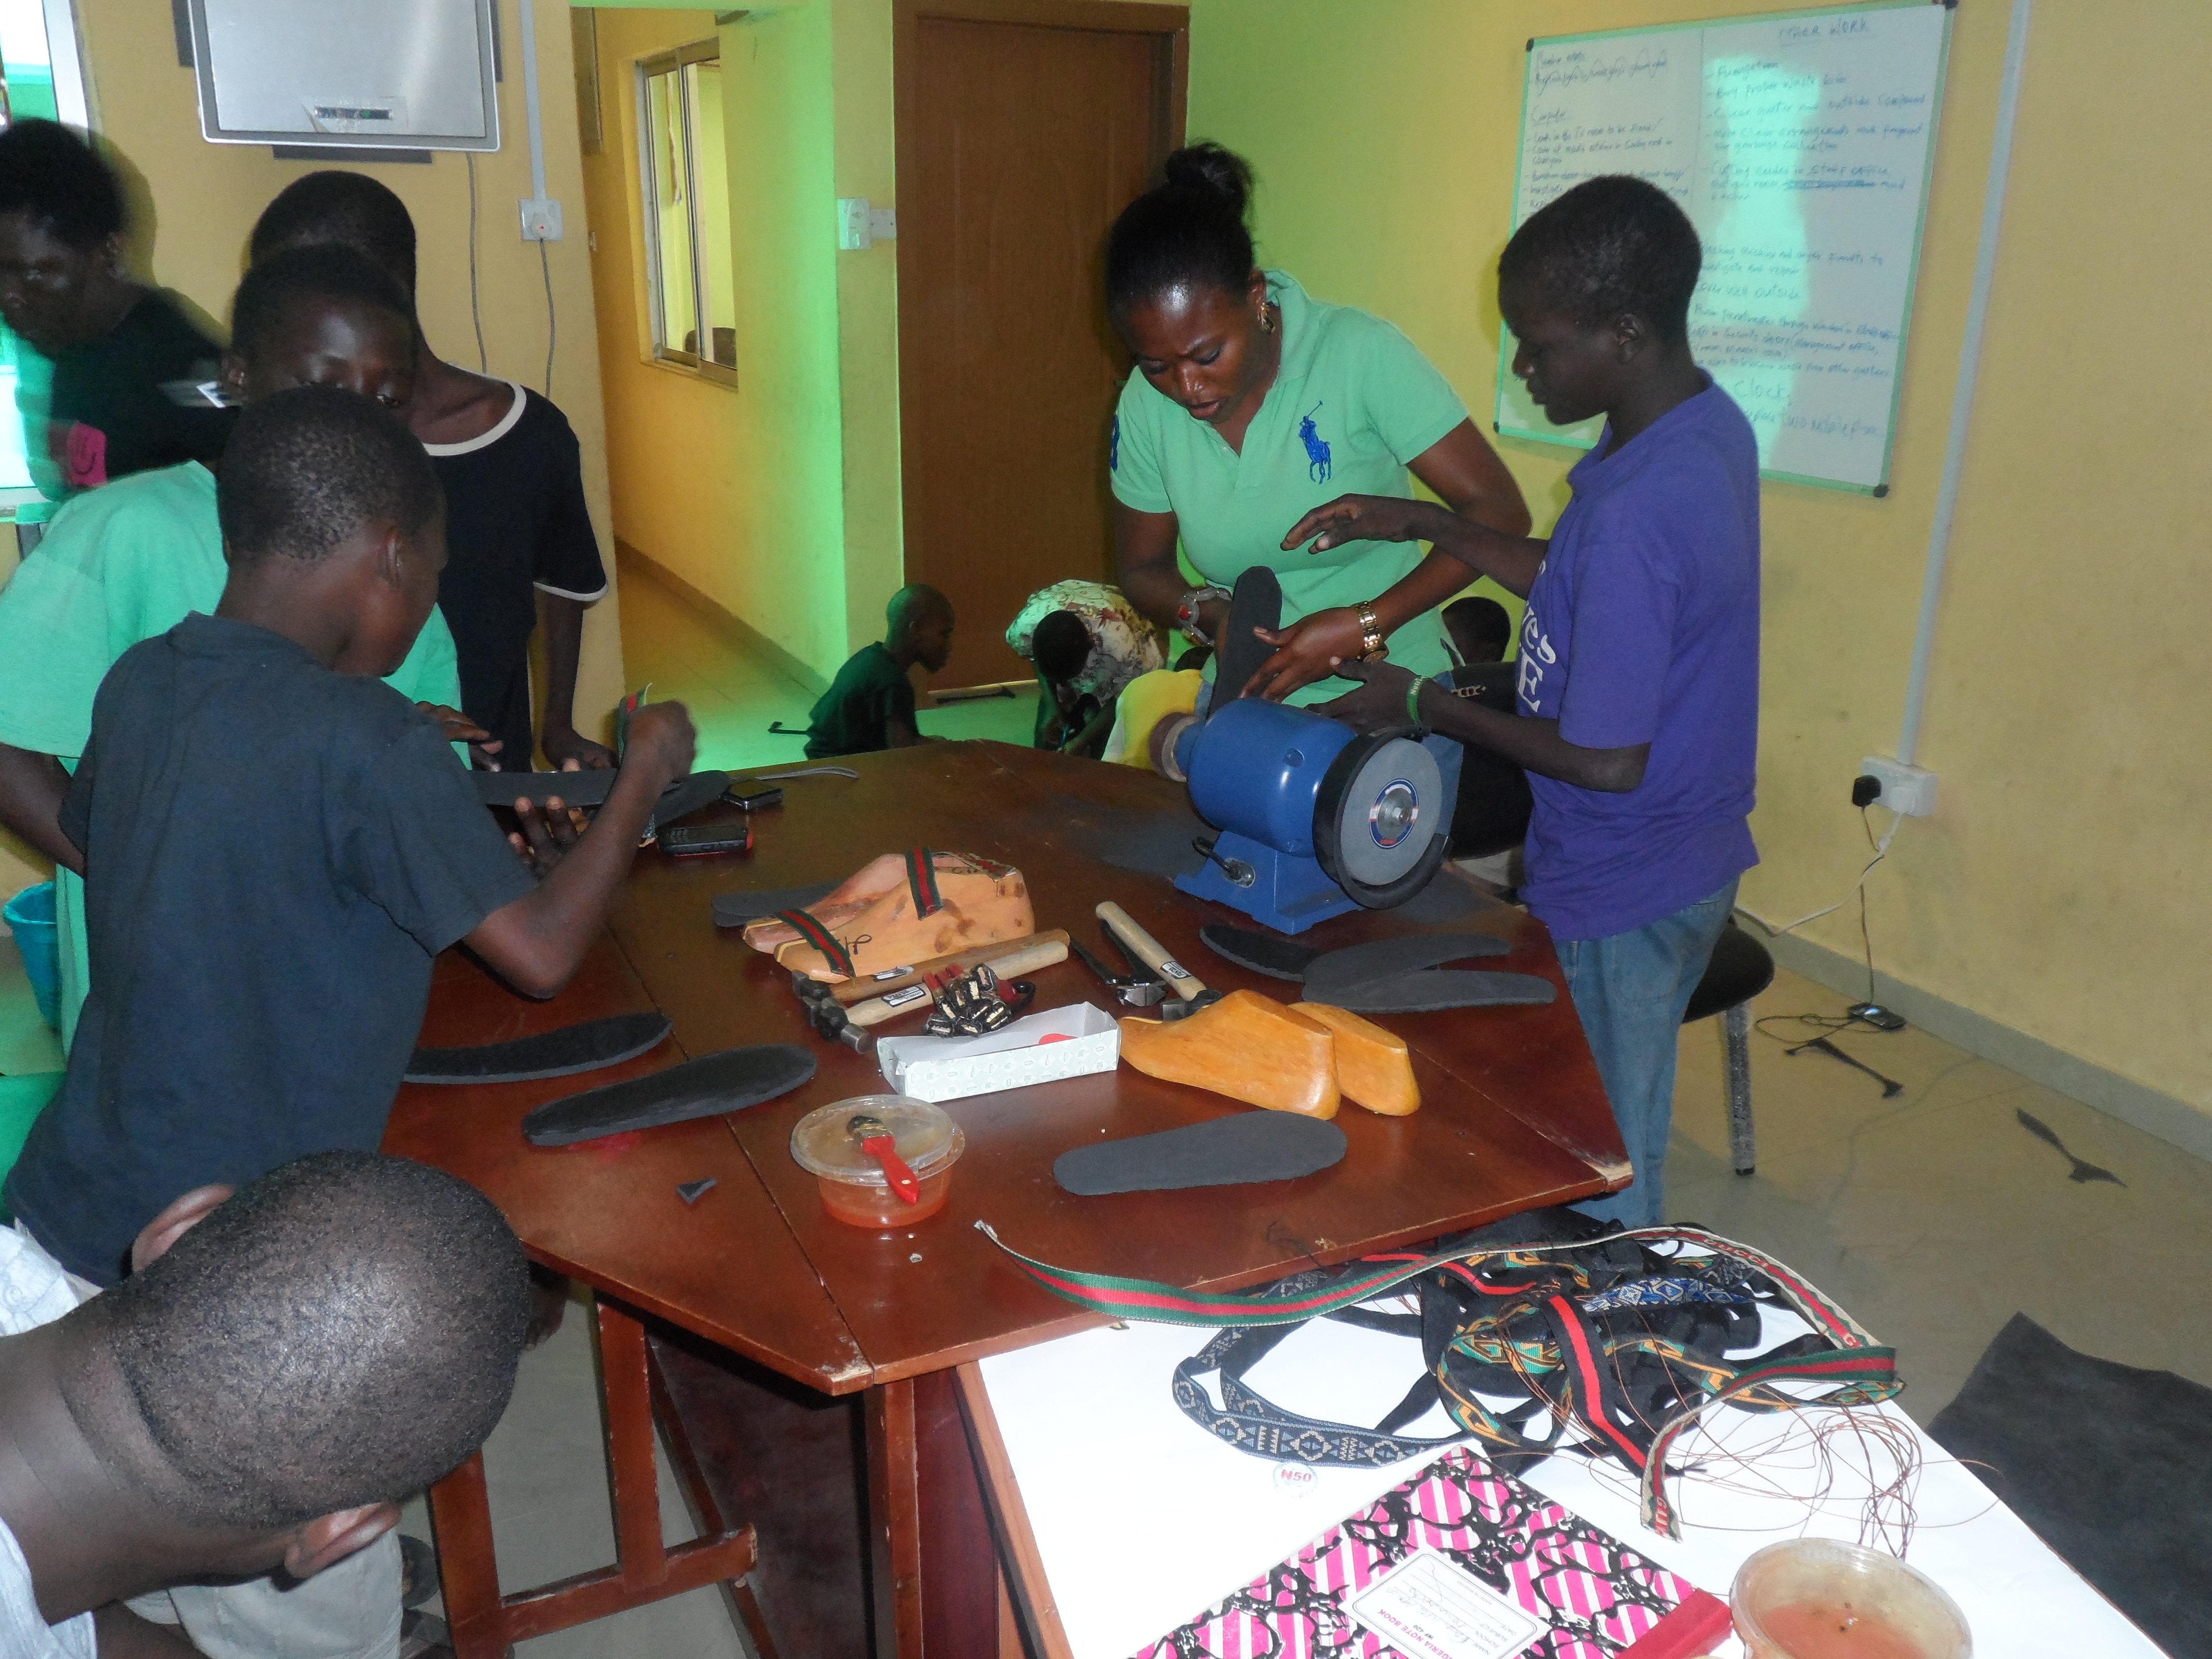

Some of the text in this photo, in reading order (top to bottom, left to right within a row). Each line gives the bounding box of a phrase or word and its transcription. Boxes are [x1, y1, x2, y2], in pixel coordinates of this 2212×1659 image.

[1704, 1238, 1769, 1267] GUCCI
[1377, 1608, 1453, 1659] IGERIA NOTE BOOK
[1413, 1624, 1434, 1640] WF 420
[1474, 1630, 1500, 1650] SCHOOL
[1479, 1623, 1509, 1643] SUBJECT
[1500, 1623, 1517, 1637] DATE
[1471, 1641, 1491, 1656] NAME
